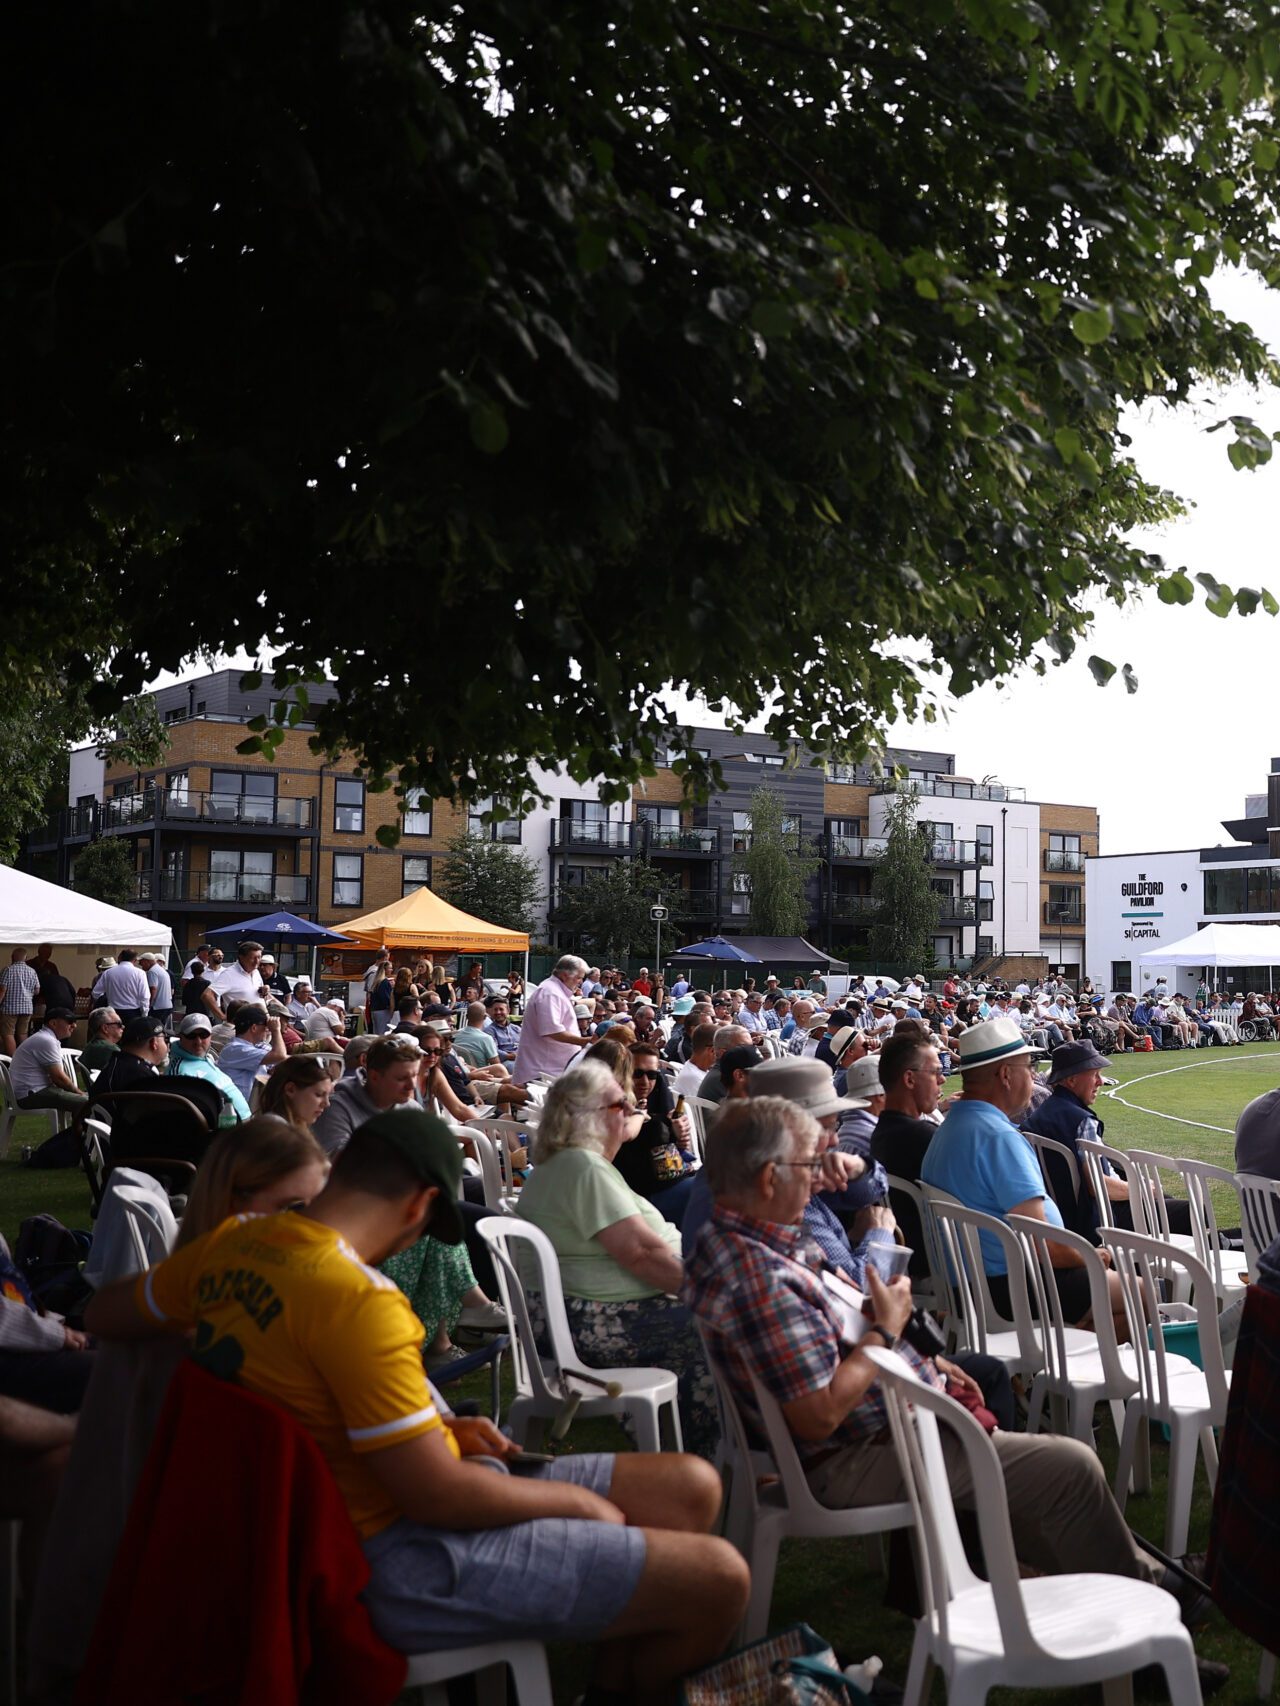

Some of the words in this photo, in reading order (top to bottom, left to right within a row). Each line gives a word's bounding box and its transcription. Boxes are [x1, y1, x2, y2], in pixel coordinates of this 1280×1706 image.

[1138, 873, 1147, 881] THE
[1121, 881, 1164, 896] GUILDFORD
[1130, 897, 1155, 907] PAVILION
[1133, 929, 1160, 938] CAPITAL
